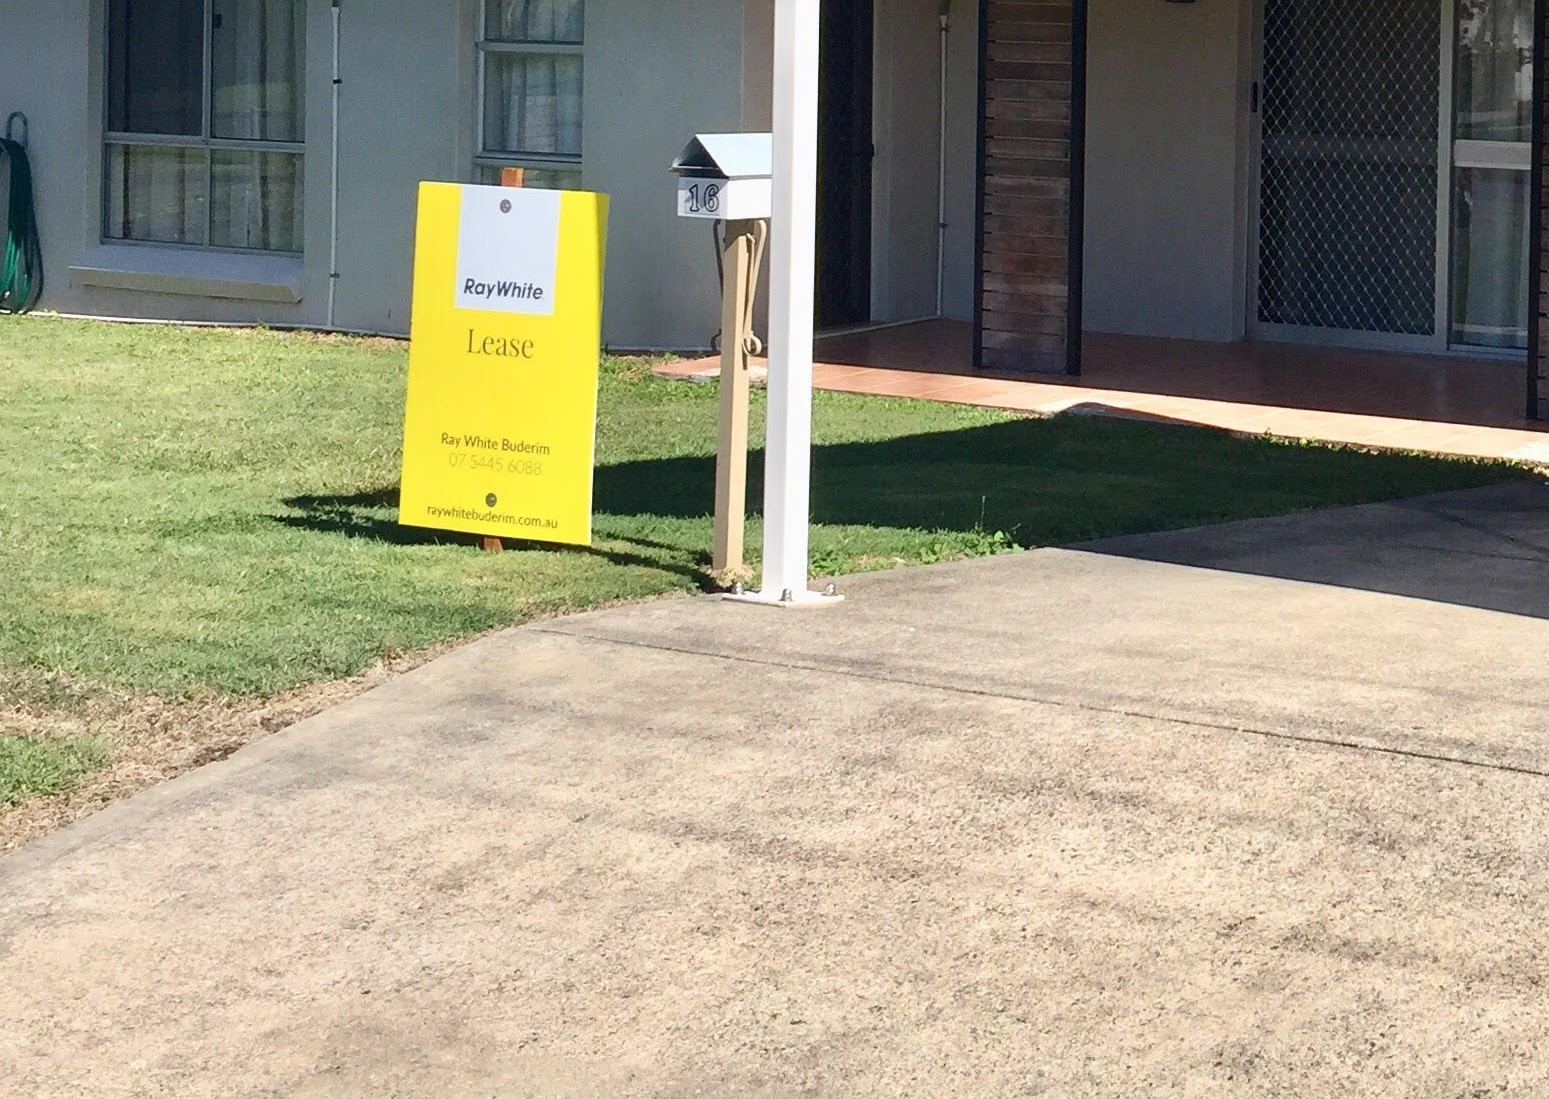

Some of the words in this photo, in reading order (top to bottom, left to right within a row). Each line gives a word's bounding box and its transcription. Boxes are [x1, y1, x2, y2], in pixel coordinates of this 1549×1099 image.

[688, 183, 720, 213] 16
[467, 328, 535, 359] Lease
[441, 432, 461, 448] Ray
[464, 434, 499, 451] White
[501, 438, 550, 455] Buderim
[448, 452, 466, 468] 07
[470, 454, 503, 472] 5445
[507, 459, 543, 476] 6088
[427, 505, 558, 529] raywhitebuderim.com.au
